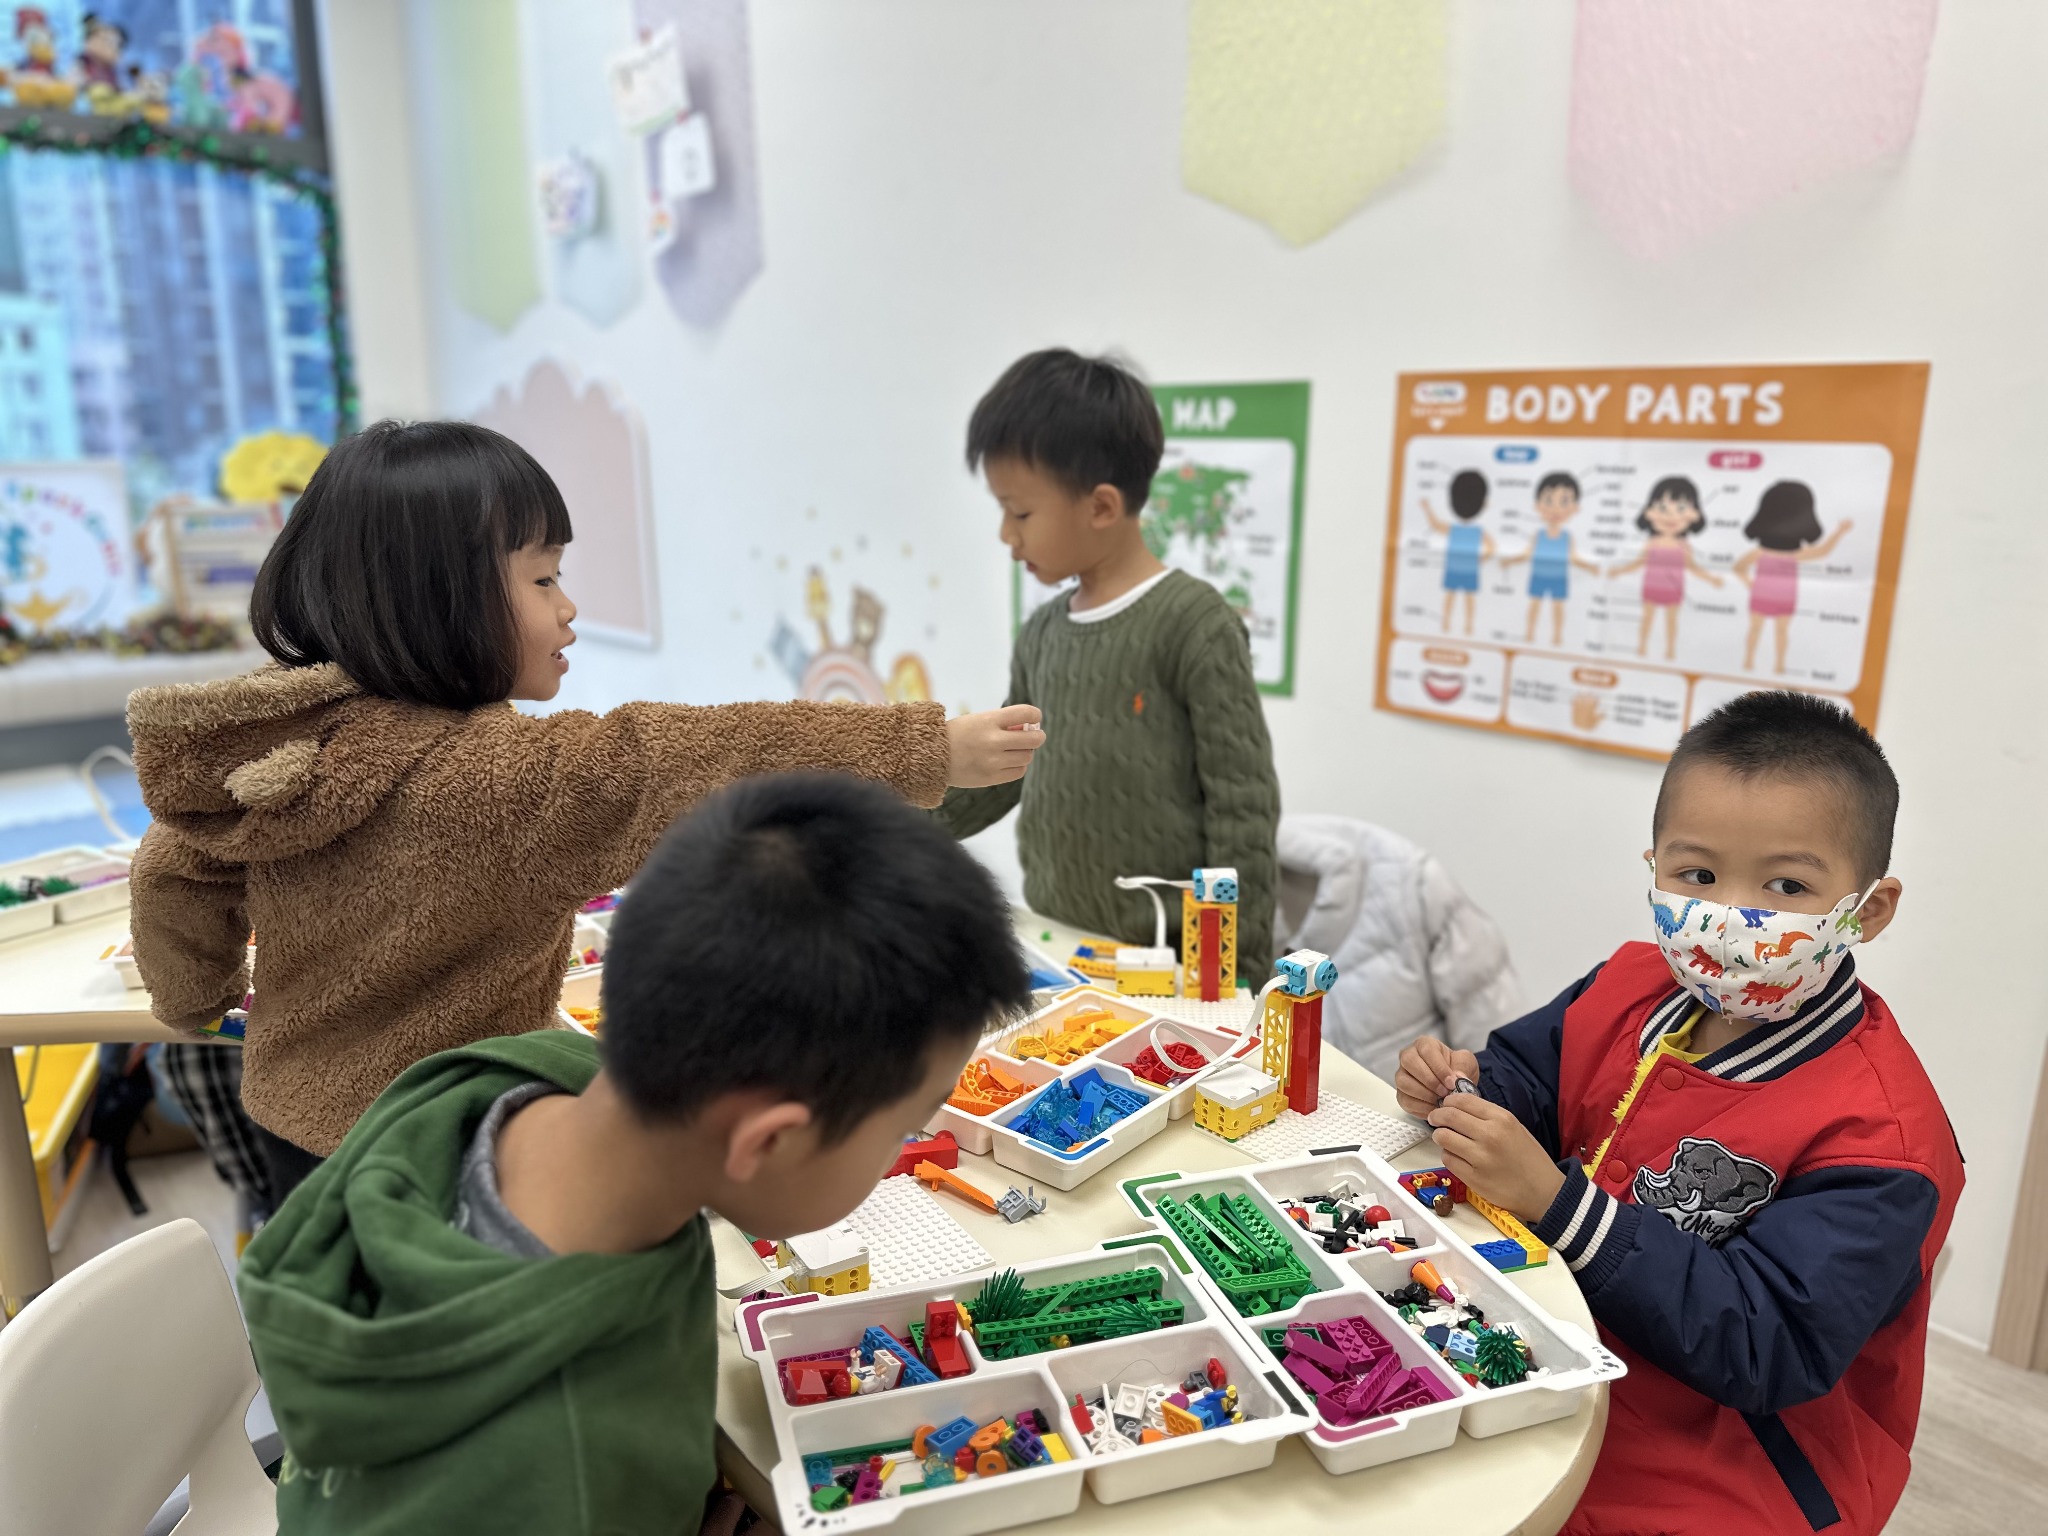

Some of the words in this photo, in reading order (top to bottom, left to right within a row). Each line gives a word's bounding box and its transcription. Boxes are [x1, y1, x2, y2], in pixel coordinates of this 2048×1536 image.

[1172, 396, 1237, 431] MAP
[1486, 384, 1610, 423] BODY
[1625, 382, 1784, 426] PARTS
